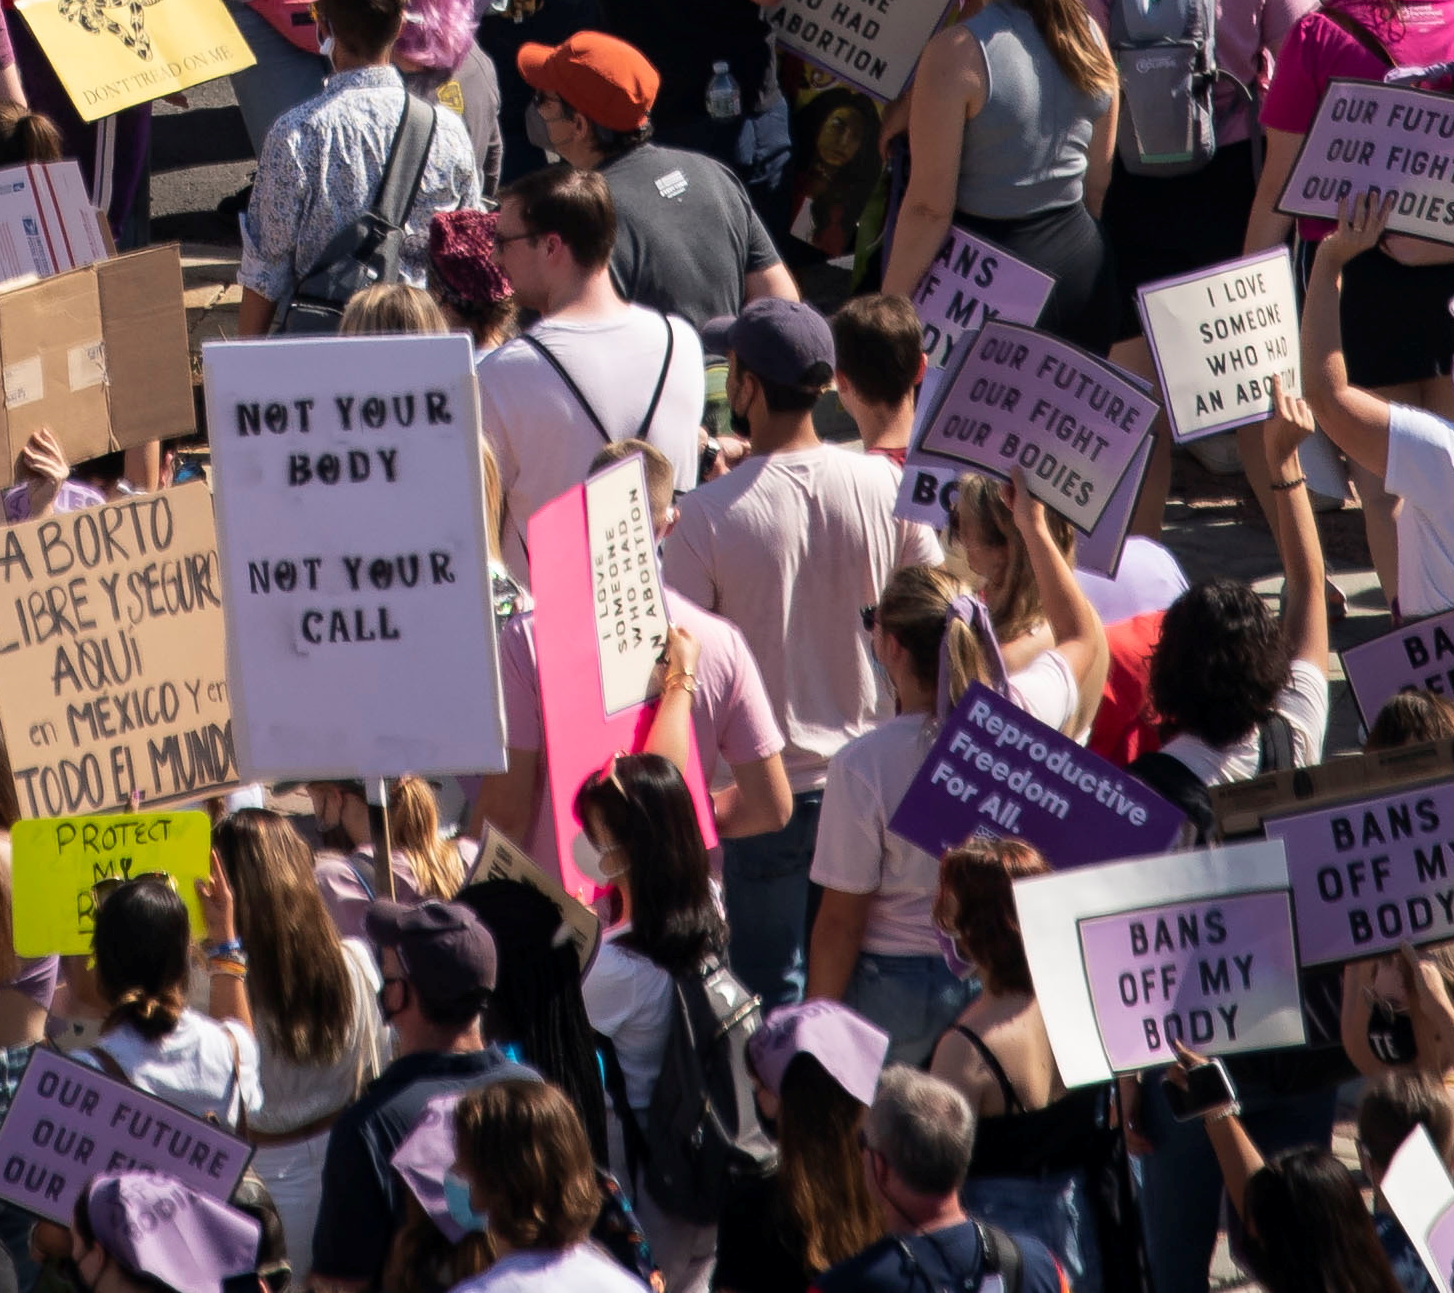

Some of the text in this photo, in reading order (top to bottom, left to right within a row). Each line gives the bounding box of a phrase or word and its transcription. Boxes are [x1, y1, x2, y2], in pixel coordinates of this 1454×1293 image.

[236, 391, 453, 438] NOT YOUR
[289, 450, 398, 485] BODY
[248, 551, 456, 596] NOT YOUR
[301, 607, 401, 645] CALL
[947, 729, 1071, 821] Freedom
[966, 699, 1147, 829] Reproductive
[930, 763, 1022, 834] For All.
